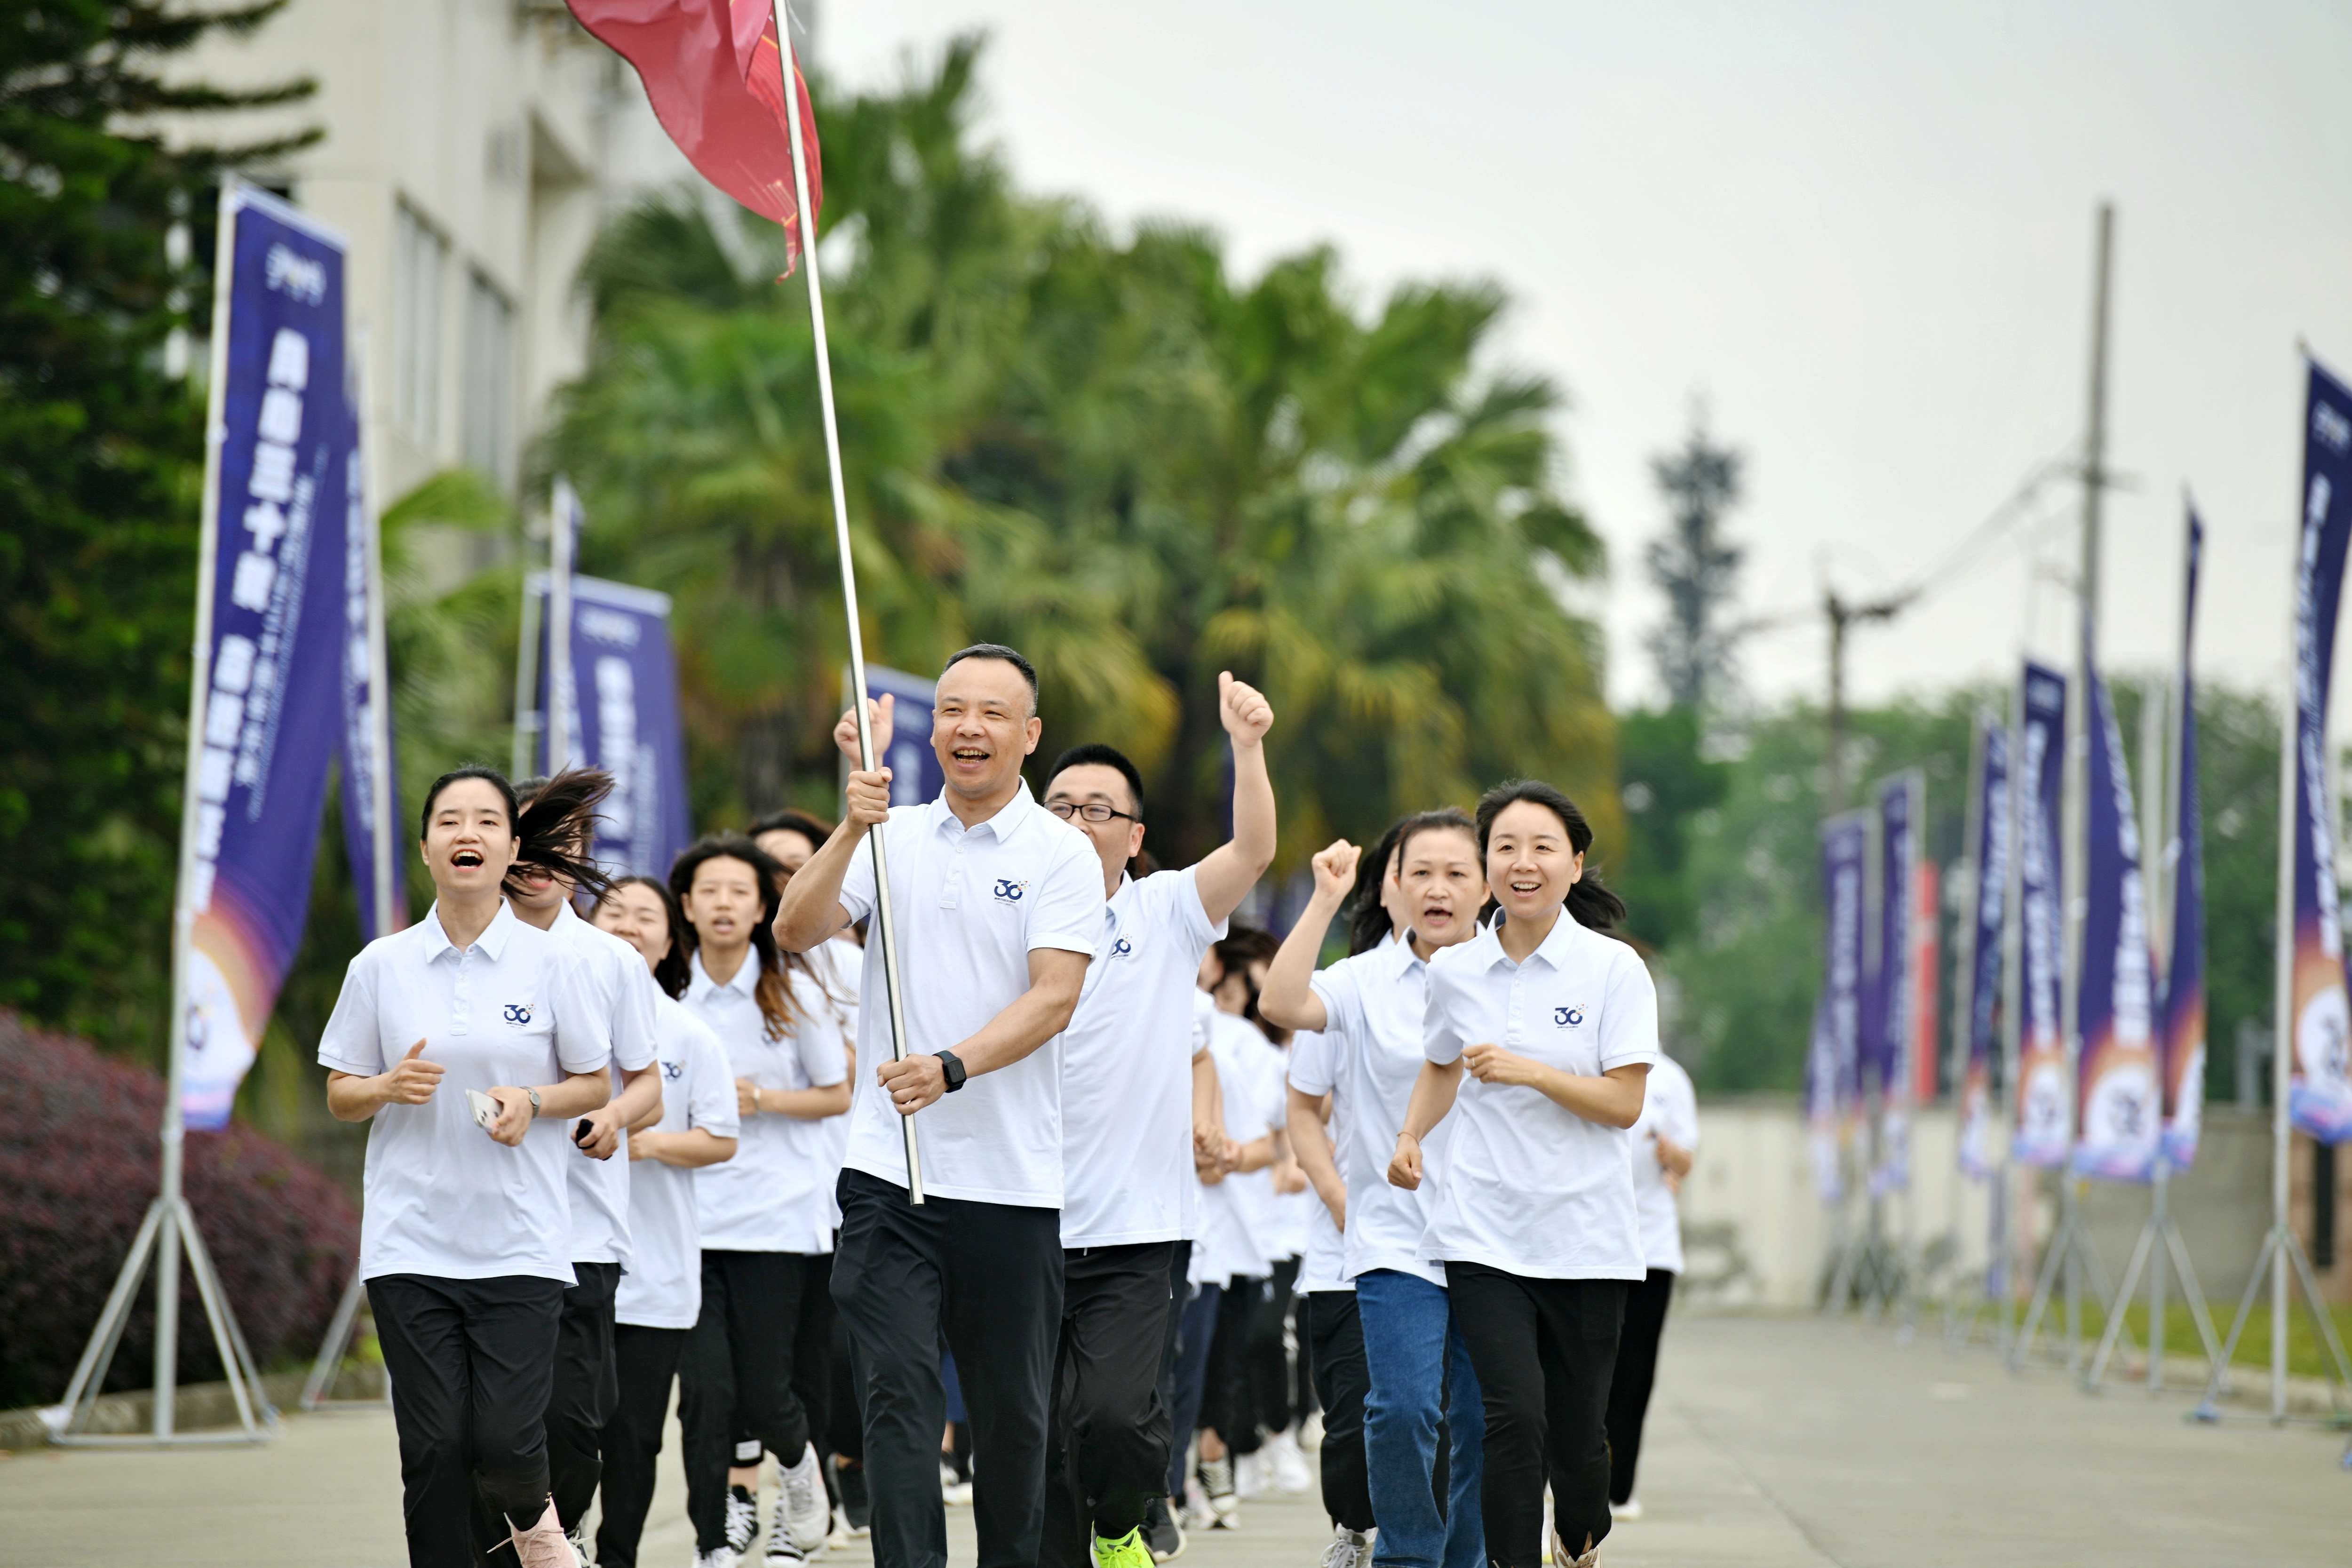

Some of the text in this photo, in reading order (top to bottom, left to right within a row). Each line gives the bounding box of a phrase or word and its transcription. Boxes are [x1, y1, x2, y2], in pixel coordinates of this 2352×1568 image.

[994, 879, 1023, 900] 30
[504, 1004, 531, 1024] 30
[1555, 1007, 1583, 1025] 30
